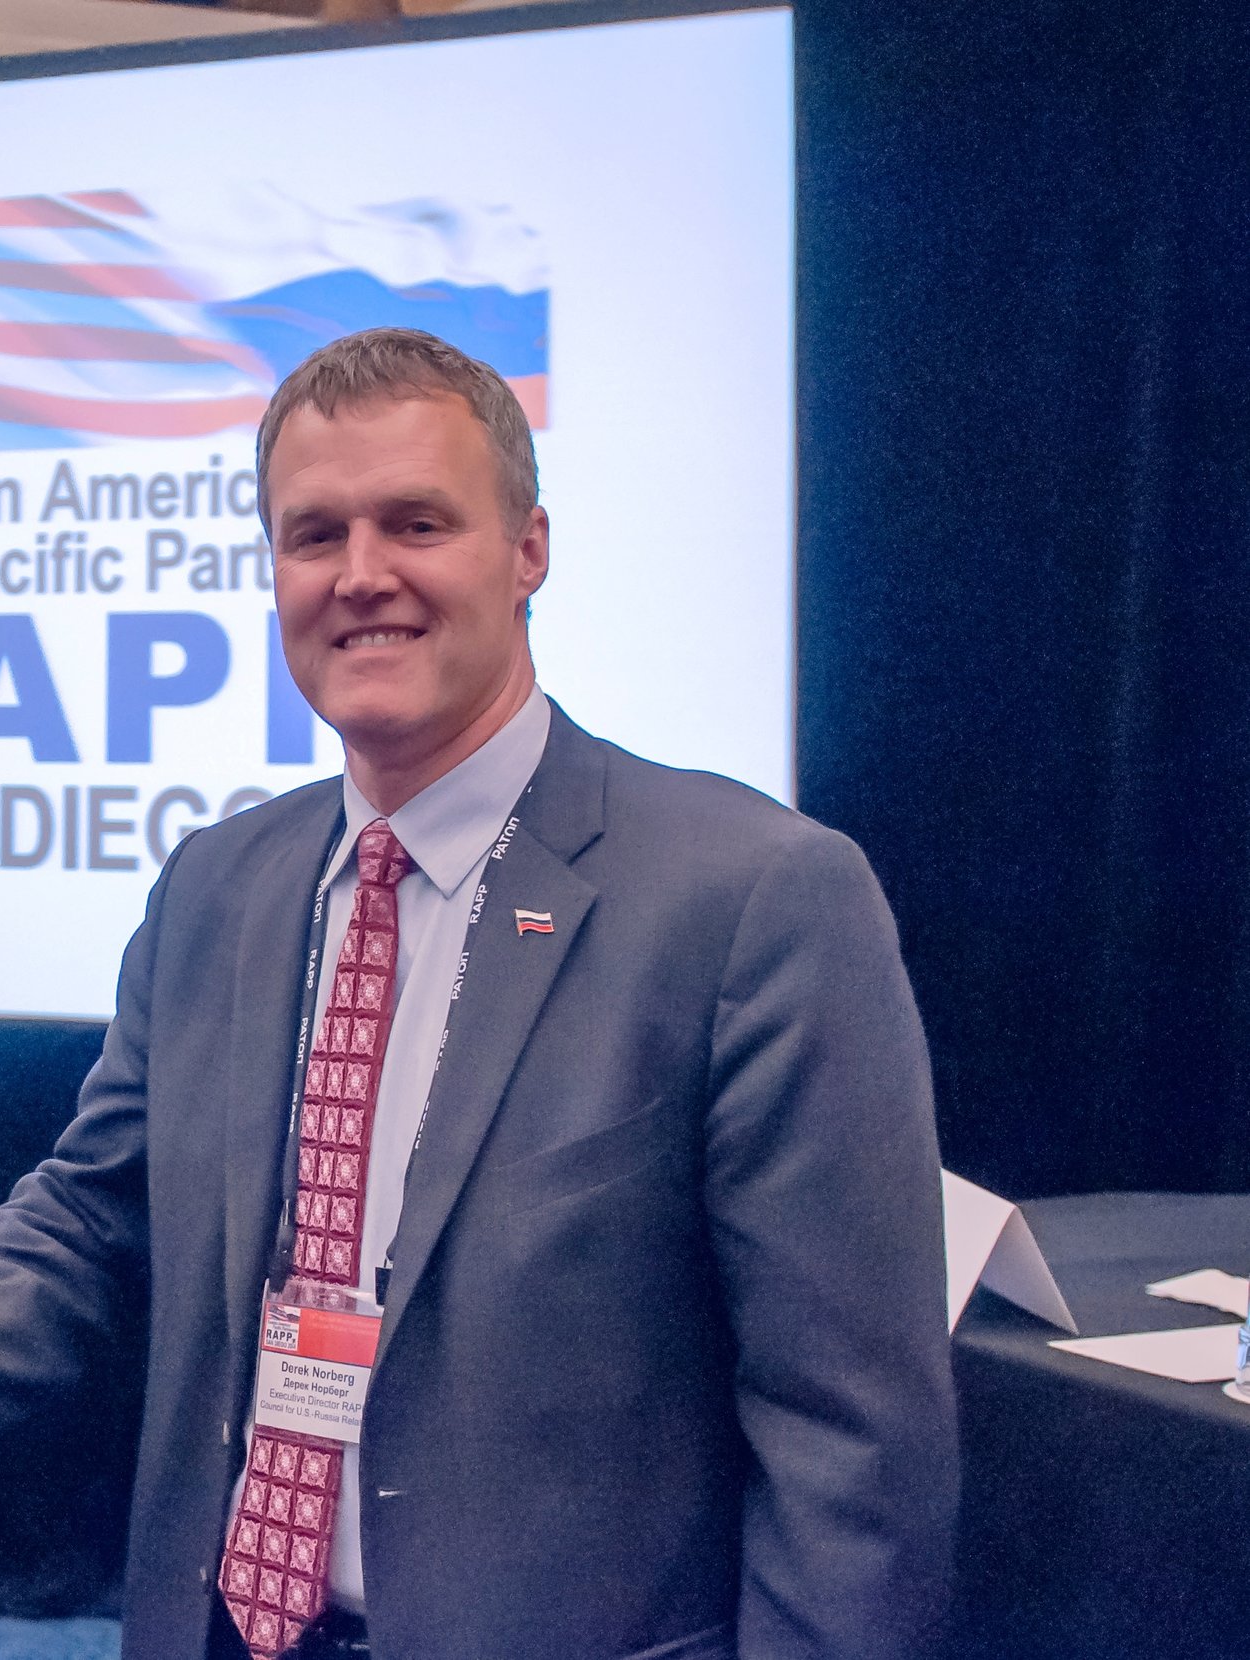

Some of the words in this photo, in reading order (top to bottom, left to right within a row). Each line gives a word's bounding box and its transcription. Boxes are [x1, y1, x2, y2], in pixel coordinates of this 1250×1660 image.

[469, 884, 488, 924] RAPP
[307, 949, 318, 990] RAPP
[281, 1361, 309, 1377] Derek
[312, 1366, 355, 1387] Norberg
[269, 1388, 305, 1403] Executive
[307, 1395, 340, 1410] Director
[283, 1377, 309, 1390] Дерек
[311, 1382, 349, 1399] Норберг
[260, 1400, 284, 1413] Council
[285, 1404, 295, 1415] for
